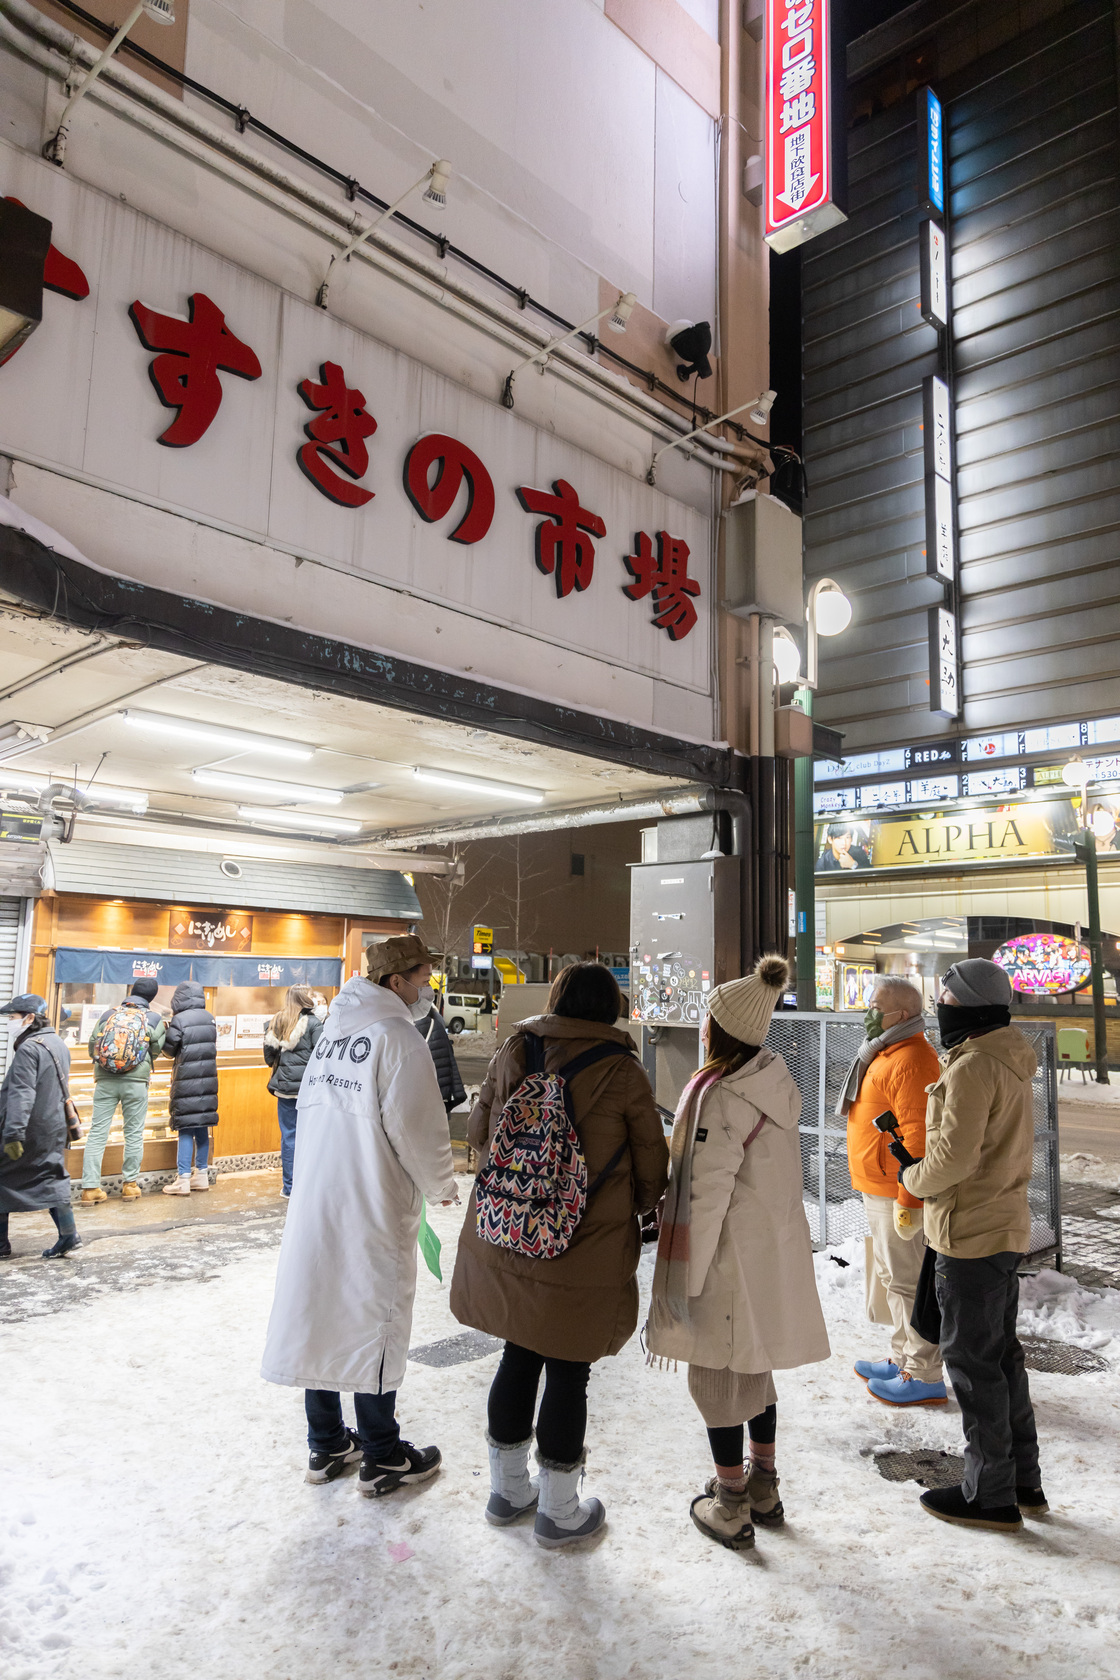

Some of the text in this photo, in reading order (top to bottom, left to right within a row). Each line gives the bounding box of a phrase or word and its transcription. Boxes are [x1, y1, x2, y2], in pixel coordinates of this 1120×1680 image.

[1018, 732, 1026, 754] 7F
[1080, 723, 1088, 746] 8F
[905, 749, 912, 769] 6F
[914, 749, 940, 763] RED
[961, 740, 968, 762] 7F
[962, 774, 969, 796] 2F
[1019, 767, 1027, 790] 3F
[906, 781, 912, 803] 1F
[896, 818, 1028, 857] ALPHA
[188, 921, 237, 947] にぎりめし
[476, 930, 491, 938] Times
[1013, 968, 1071, 985] ARVAST
[325, 1073, 363, 1092] Resorts
